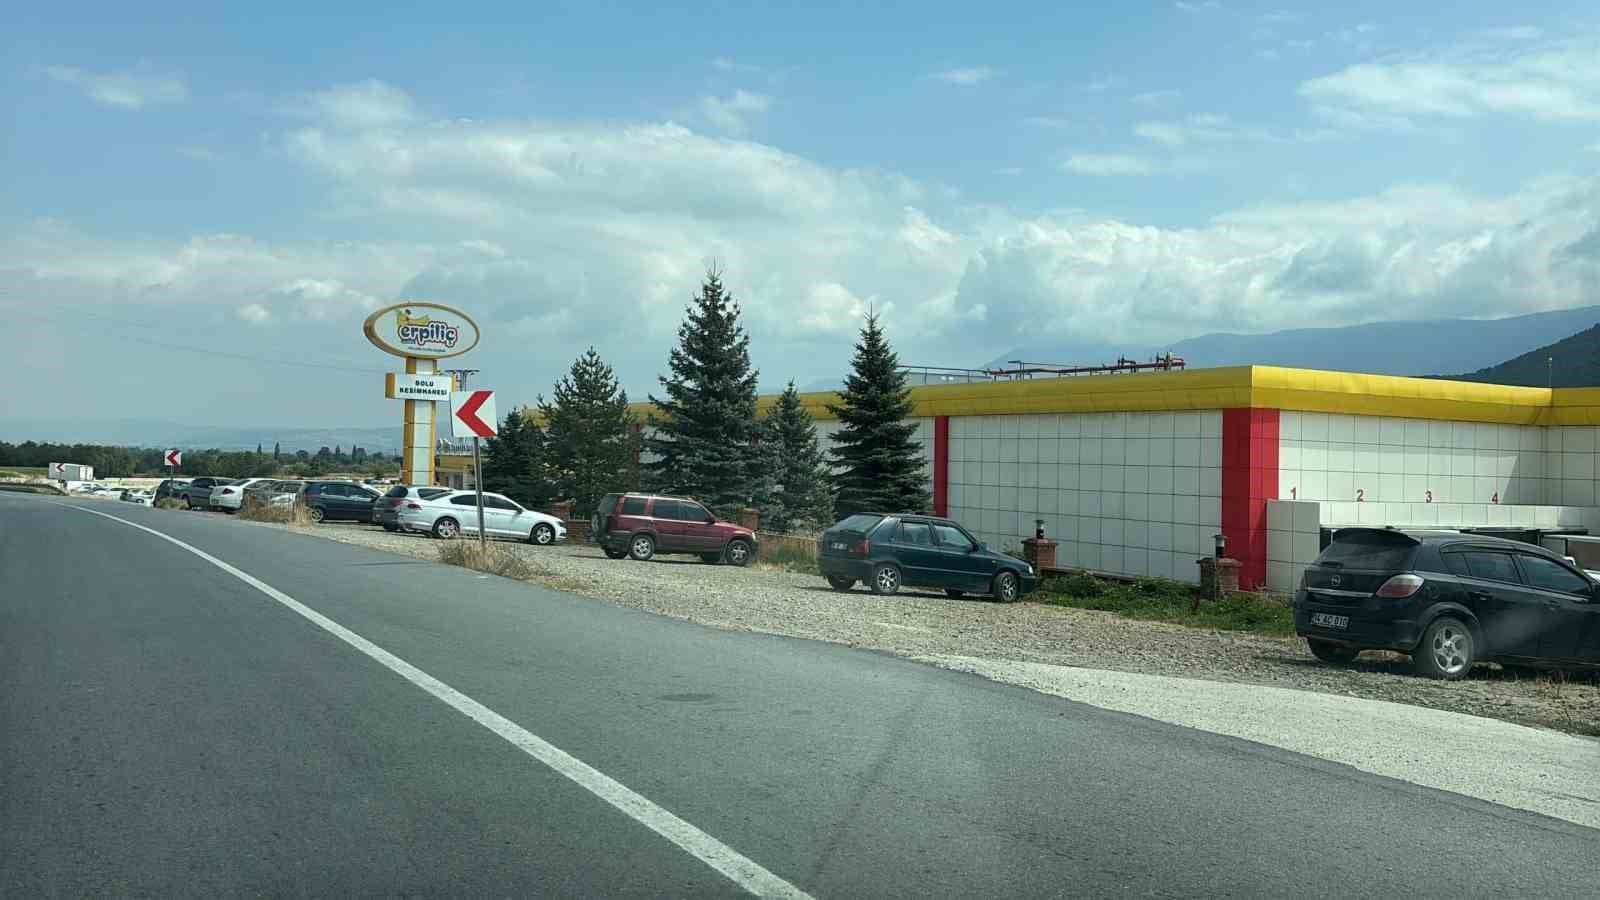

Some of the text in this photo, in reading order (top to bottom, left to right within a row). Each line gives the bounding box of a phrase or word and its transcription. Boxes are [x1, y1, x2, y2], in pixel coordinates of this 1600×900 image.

[399, 321, 457, 347] erpiliç
[1290, 487, 1297, 500] 1
[1356, 489, 1364, 502] 2
[1425, 490, 1432, 503] 3
[1491, 492, 1499, 504] 4
